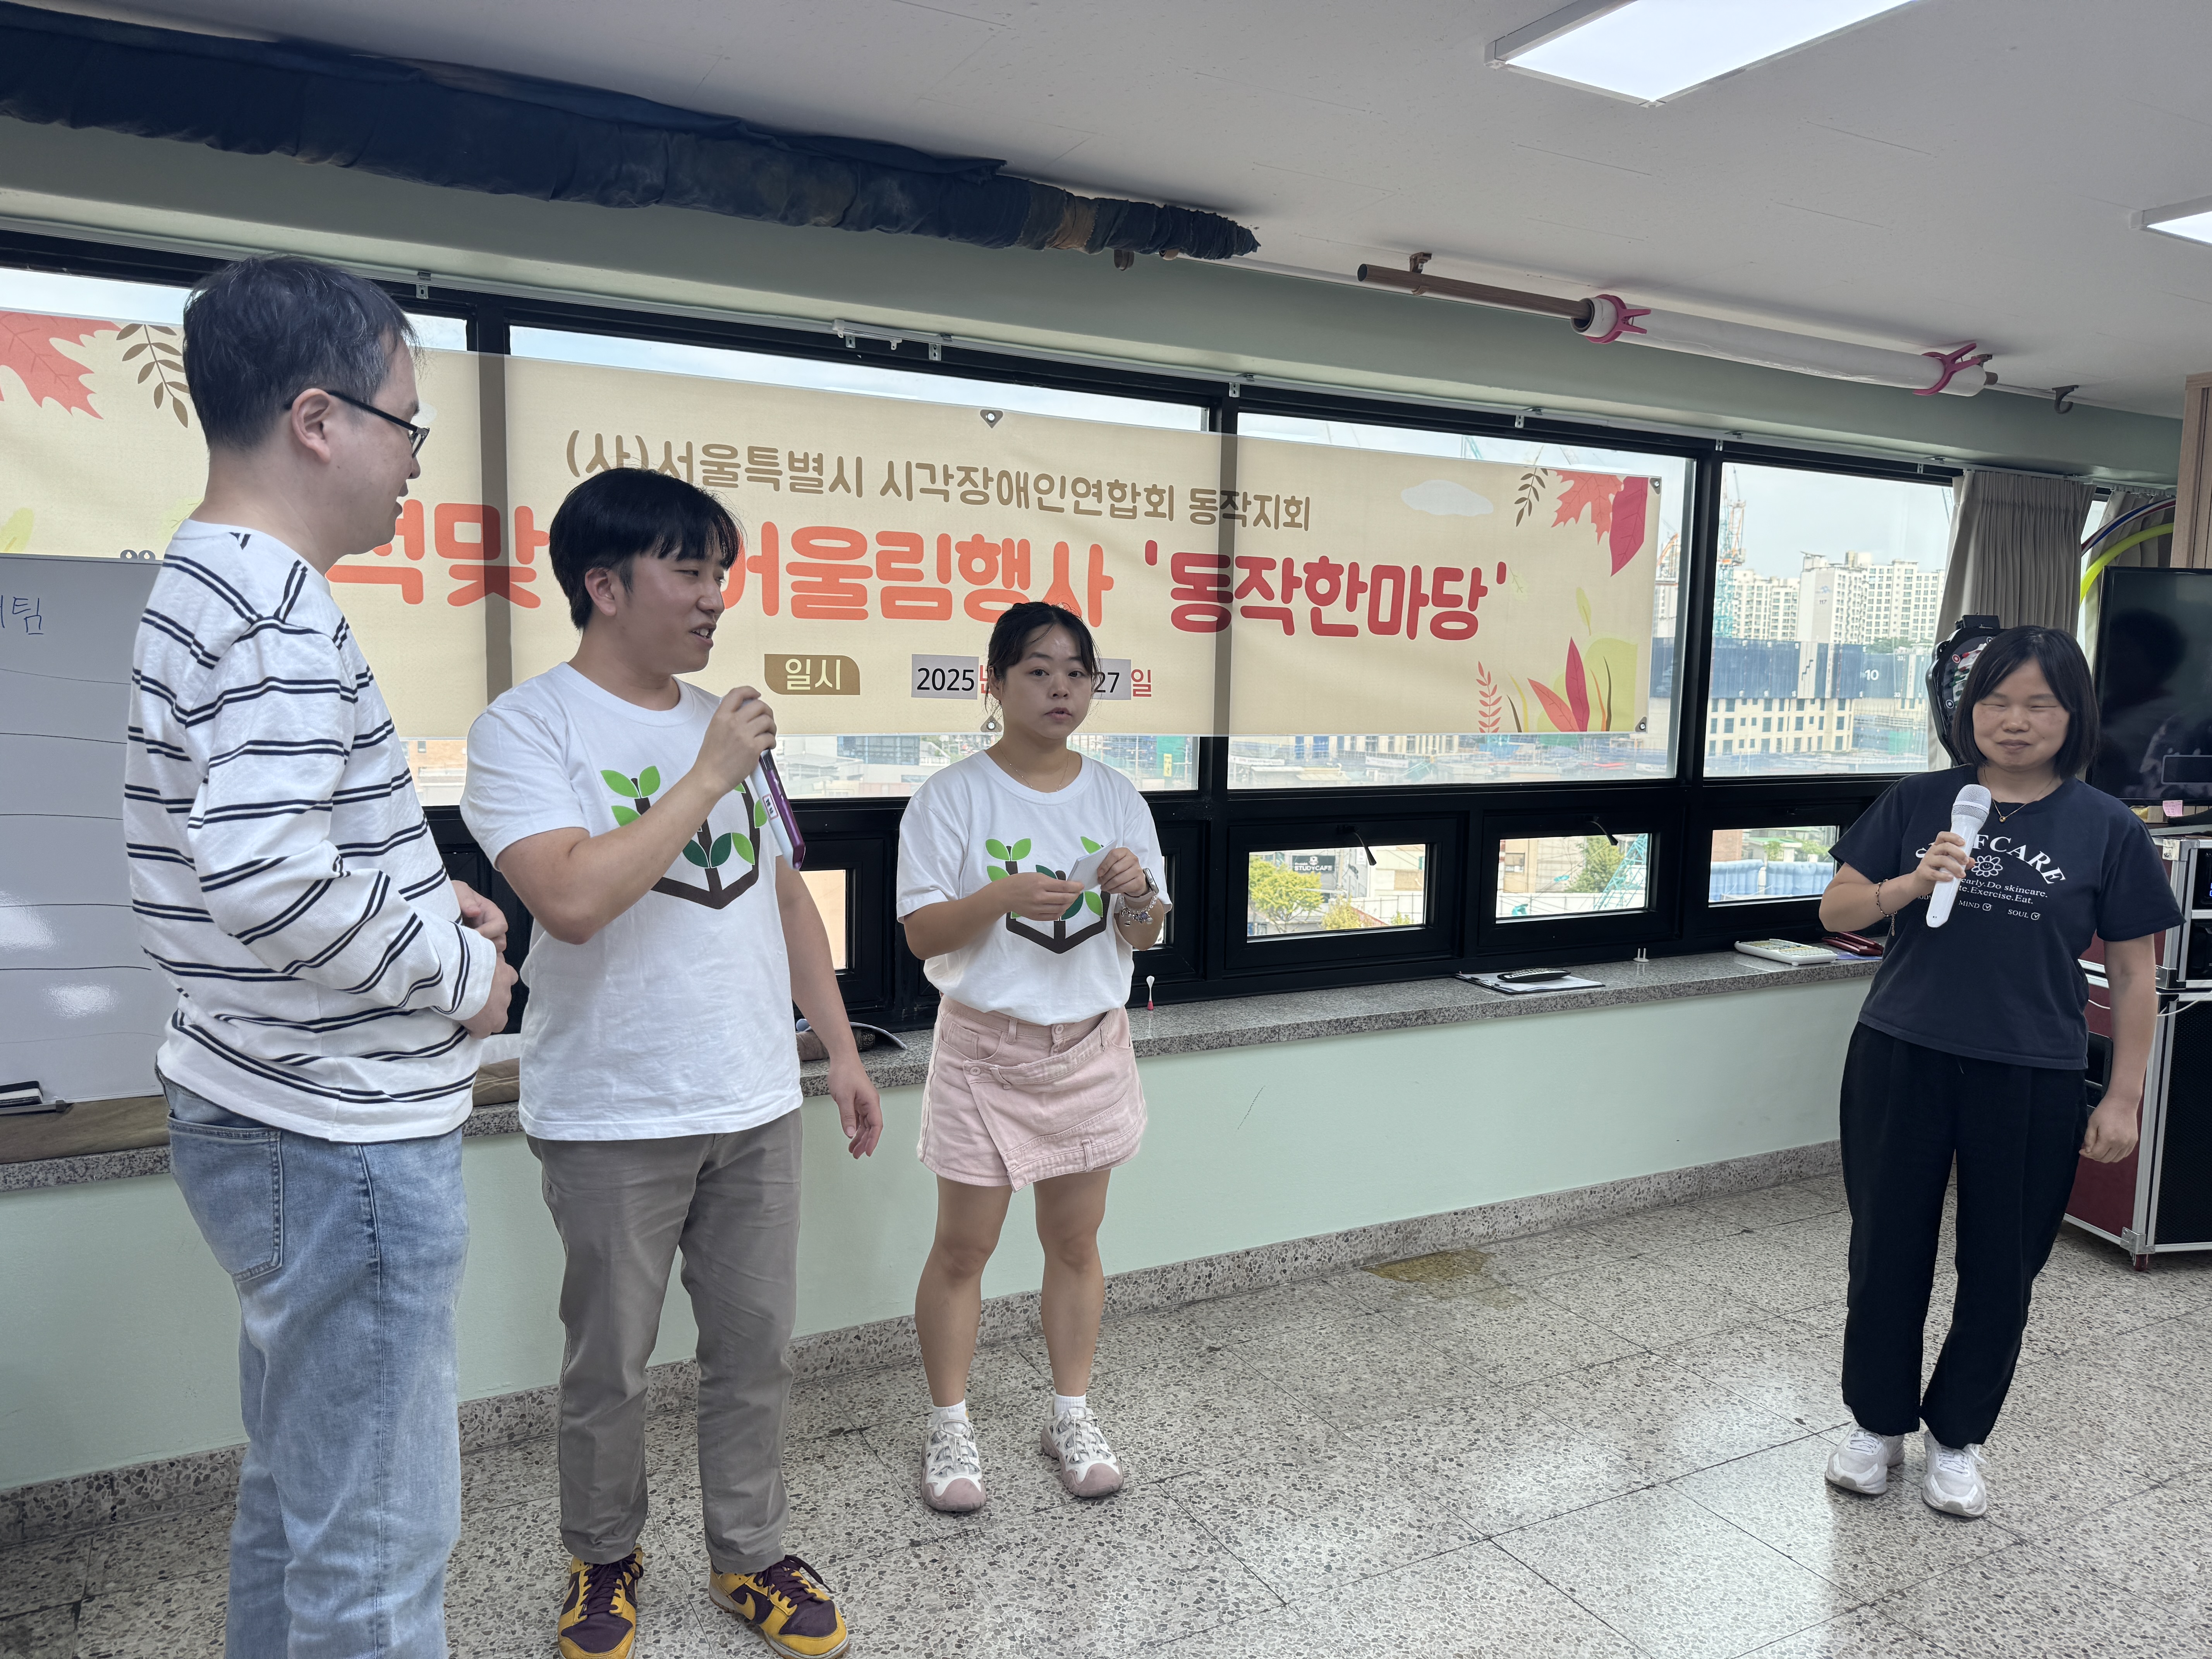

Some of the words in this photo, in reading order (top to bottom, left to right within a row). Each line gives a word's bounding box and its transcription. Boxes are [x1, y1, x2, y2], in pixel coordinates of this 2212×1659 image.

[567, 430, 863, 498] (사)서울특별시
[879, 460, 1175, 521] 시각장애인연합회
[1188, 487, 1310, 531] 동작지회
[1145, 540, 1506, 640] '동작한마당'
[785, 658, 841, 690] 일시
[1865, 669, 1879, 680] 10
[2004, 885, 2048, 898] skincare.
[1958, 900, 1980, 909] MIND
[2007, 908, 2029, 918] SOUL
